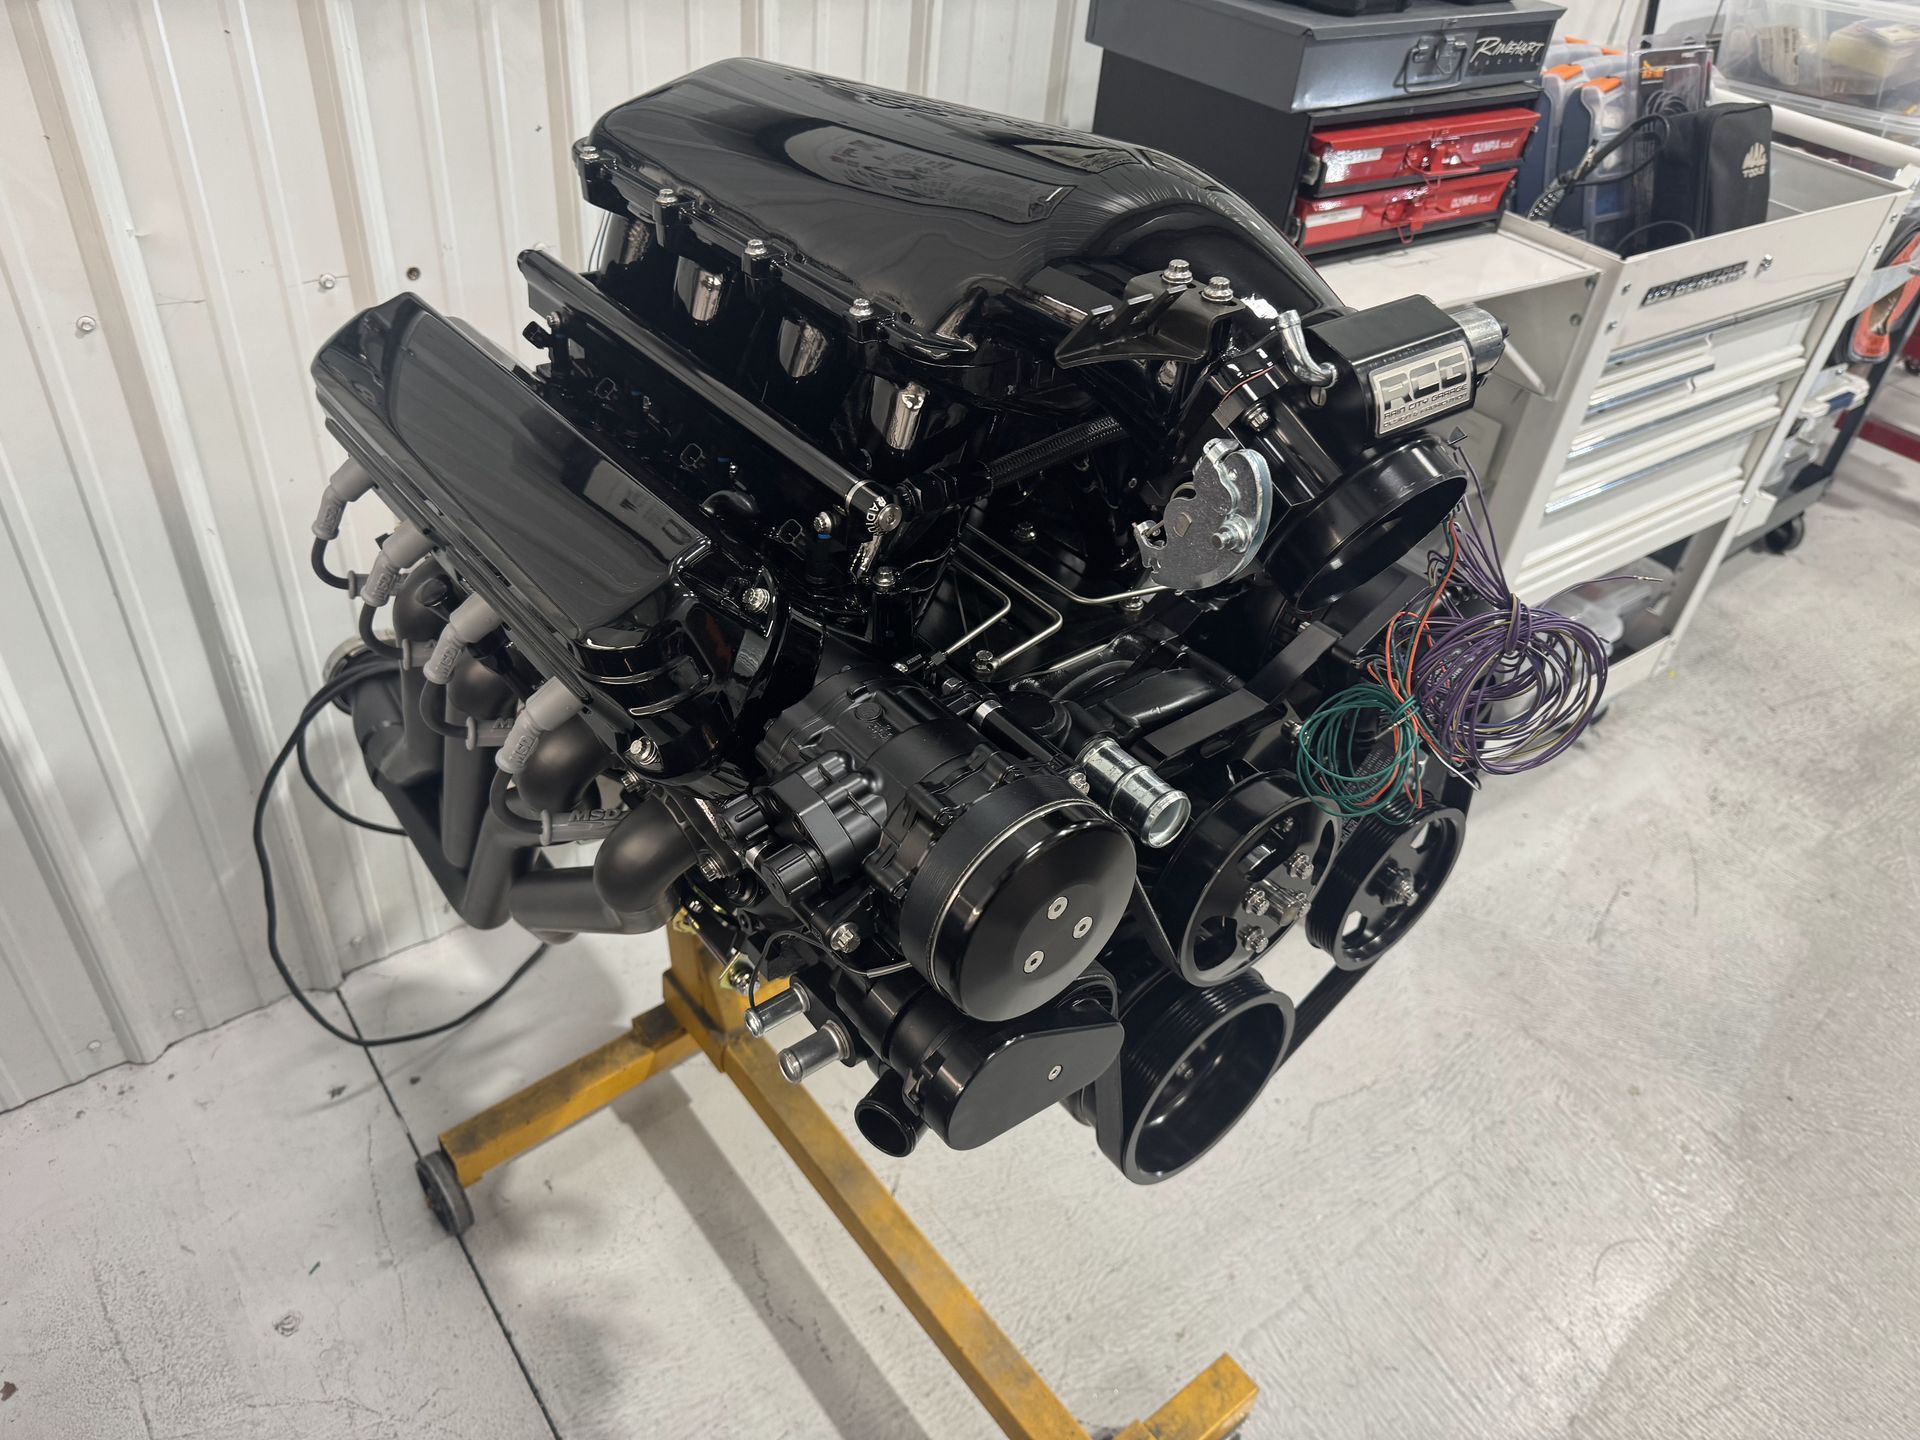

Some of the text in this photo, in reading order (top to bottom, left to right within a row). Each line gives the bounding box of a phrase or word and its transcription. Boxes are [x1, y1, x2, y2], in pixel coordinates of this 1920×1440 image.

[1469, 36, 1545, 63] RINEHART
[1379, 352, 1467, 411] RCG
[1431, 383, 1468, 402] GARAGE
[865, 496, 887, 536] RADIU
[568, 808, 622, 822] MSD
